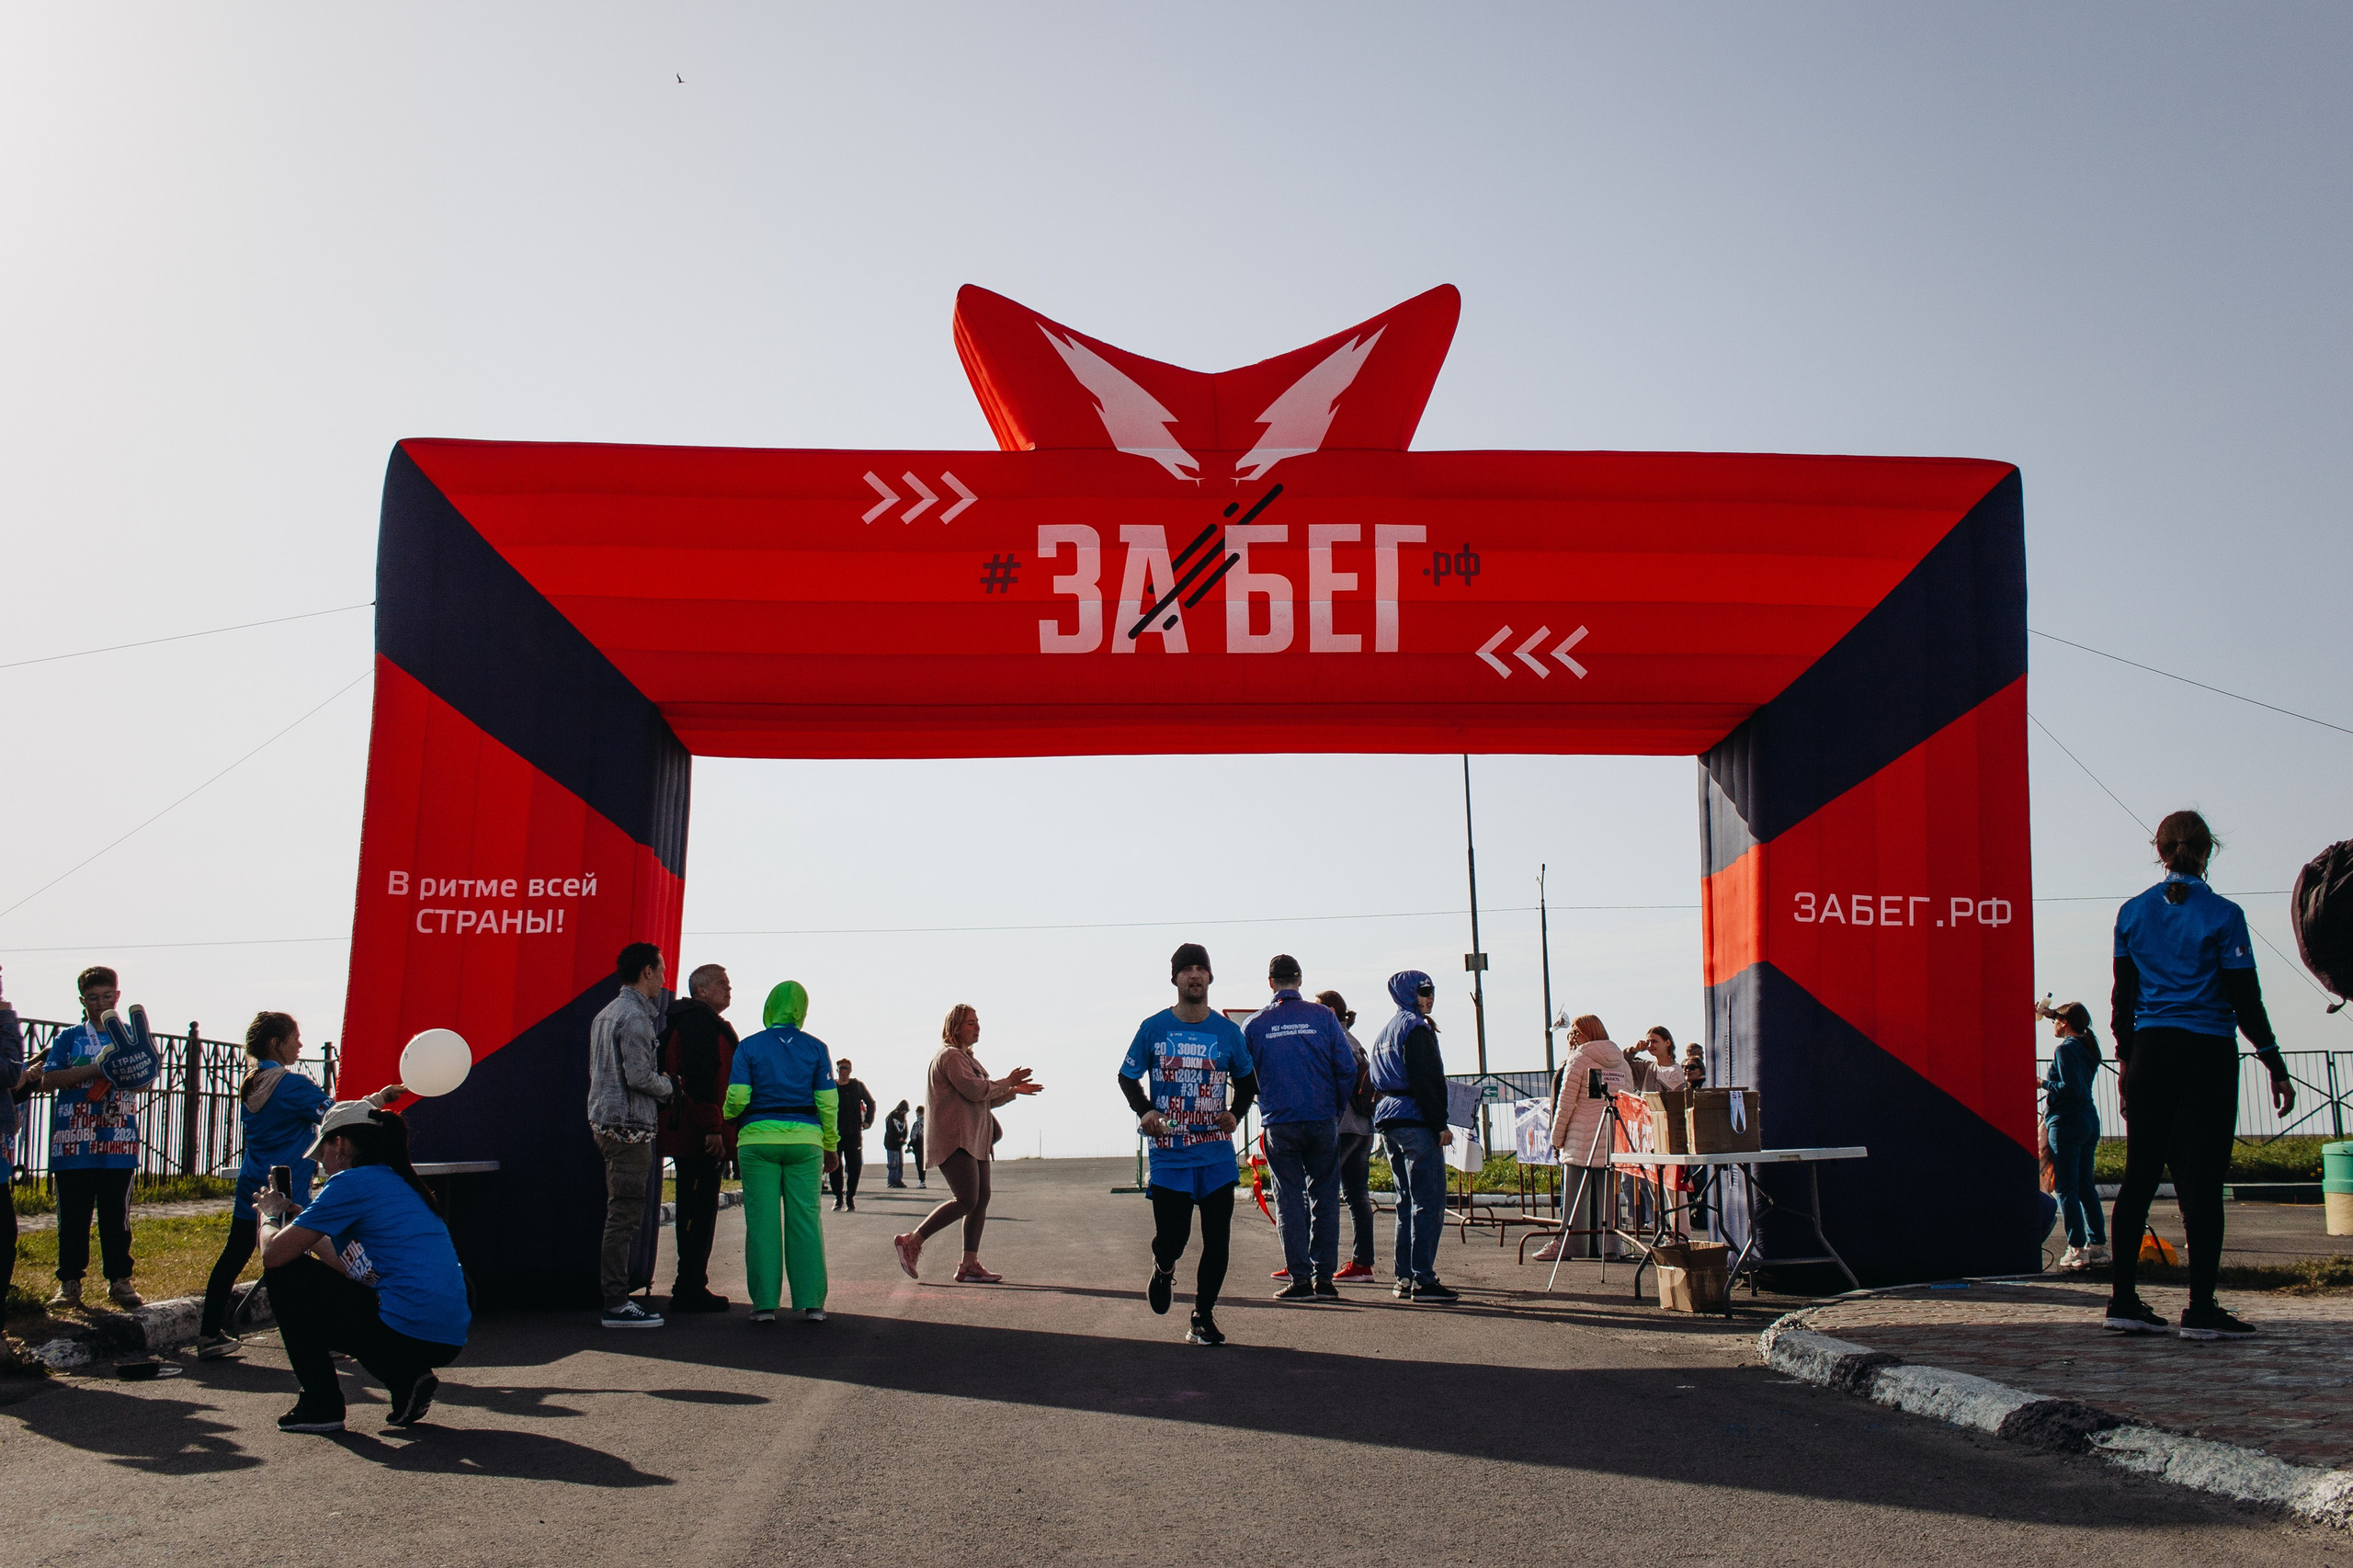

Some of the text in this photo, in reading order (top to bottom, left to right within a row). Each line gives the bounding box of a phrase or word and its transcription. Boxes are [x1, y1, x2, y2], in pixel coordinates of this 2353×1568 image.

[388, 870, 597, 900] В ритме всей
[1793, 892, 2012, 928] ЗАБЕГ.РФ
[416, 908, 564, 934] СТРАНЫ!
[1177, 1042, 1207, 1057] 30012
[119, 1058, 153, 1074] ОДНОМ
[119, 1068, 150, 1082] РИТМЕ
